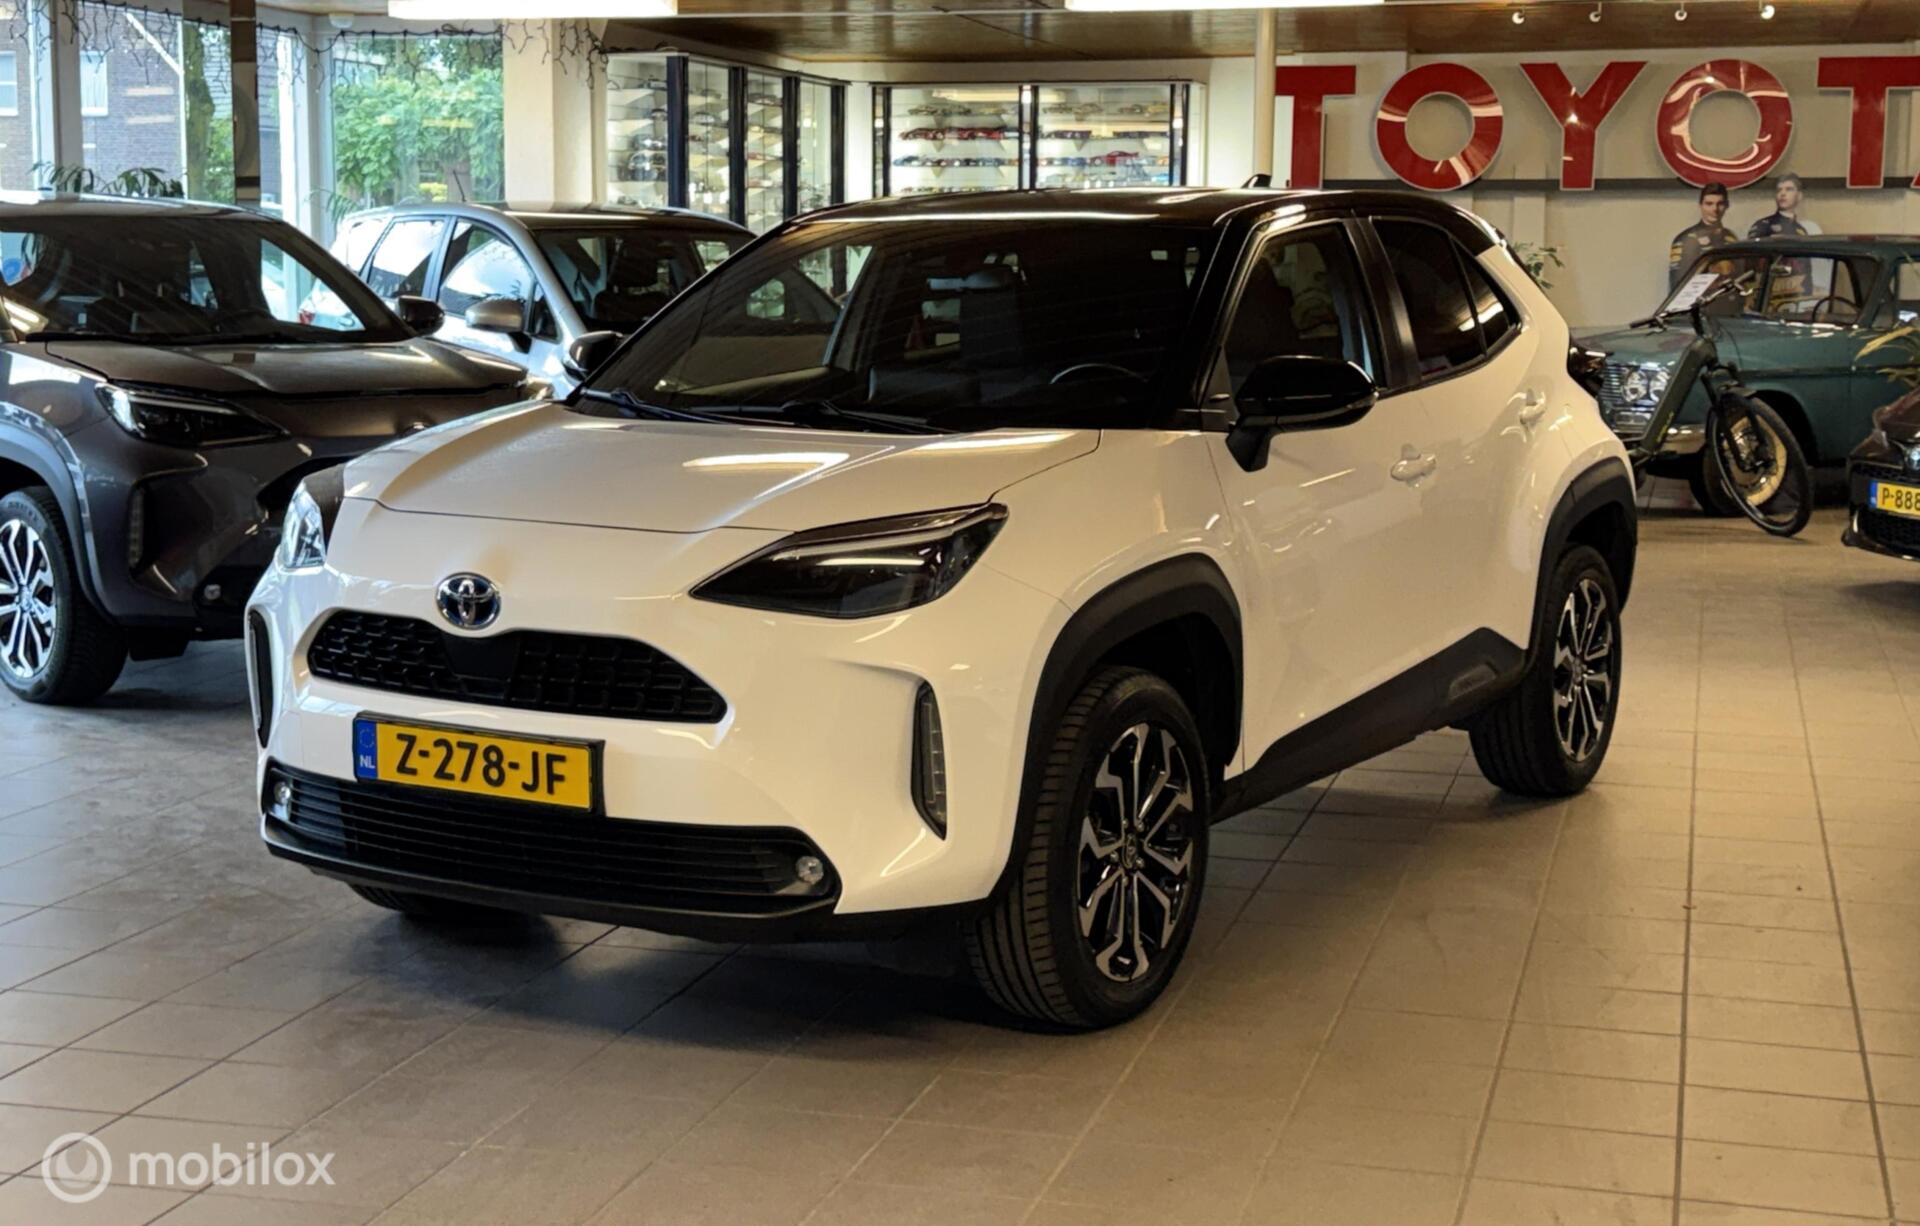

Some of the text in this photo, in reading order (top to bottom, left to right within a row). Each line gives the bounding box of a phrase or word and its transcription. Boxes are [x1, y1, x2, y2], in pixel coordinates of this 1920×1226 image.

[1275, 56, 1920, 190] TOYOT
[360, 733, 567, 795] NL Z-278-JF
